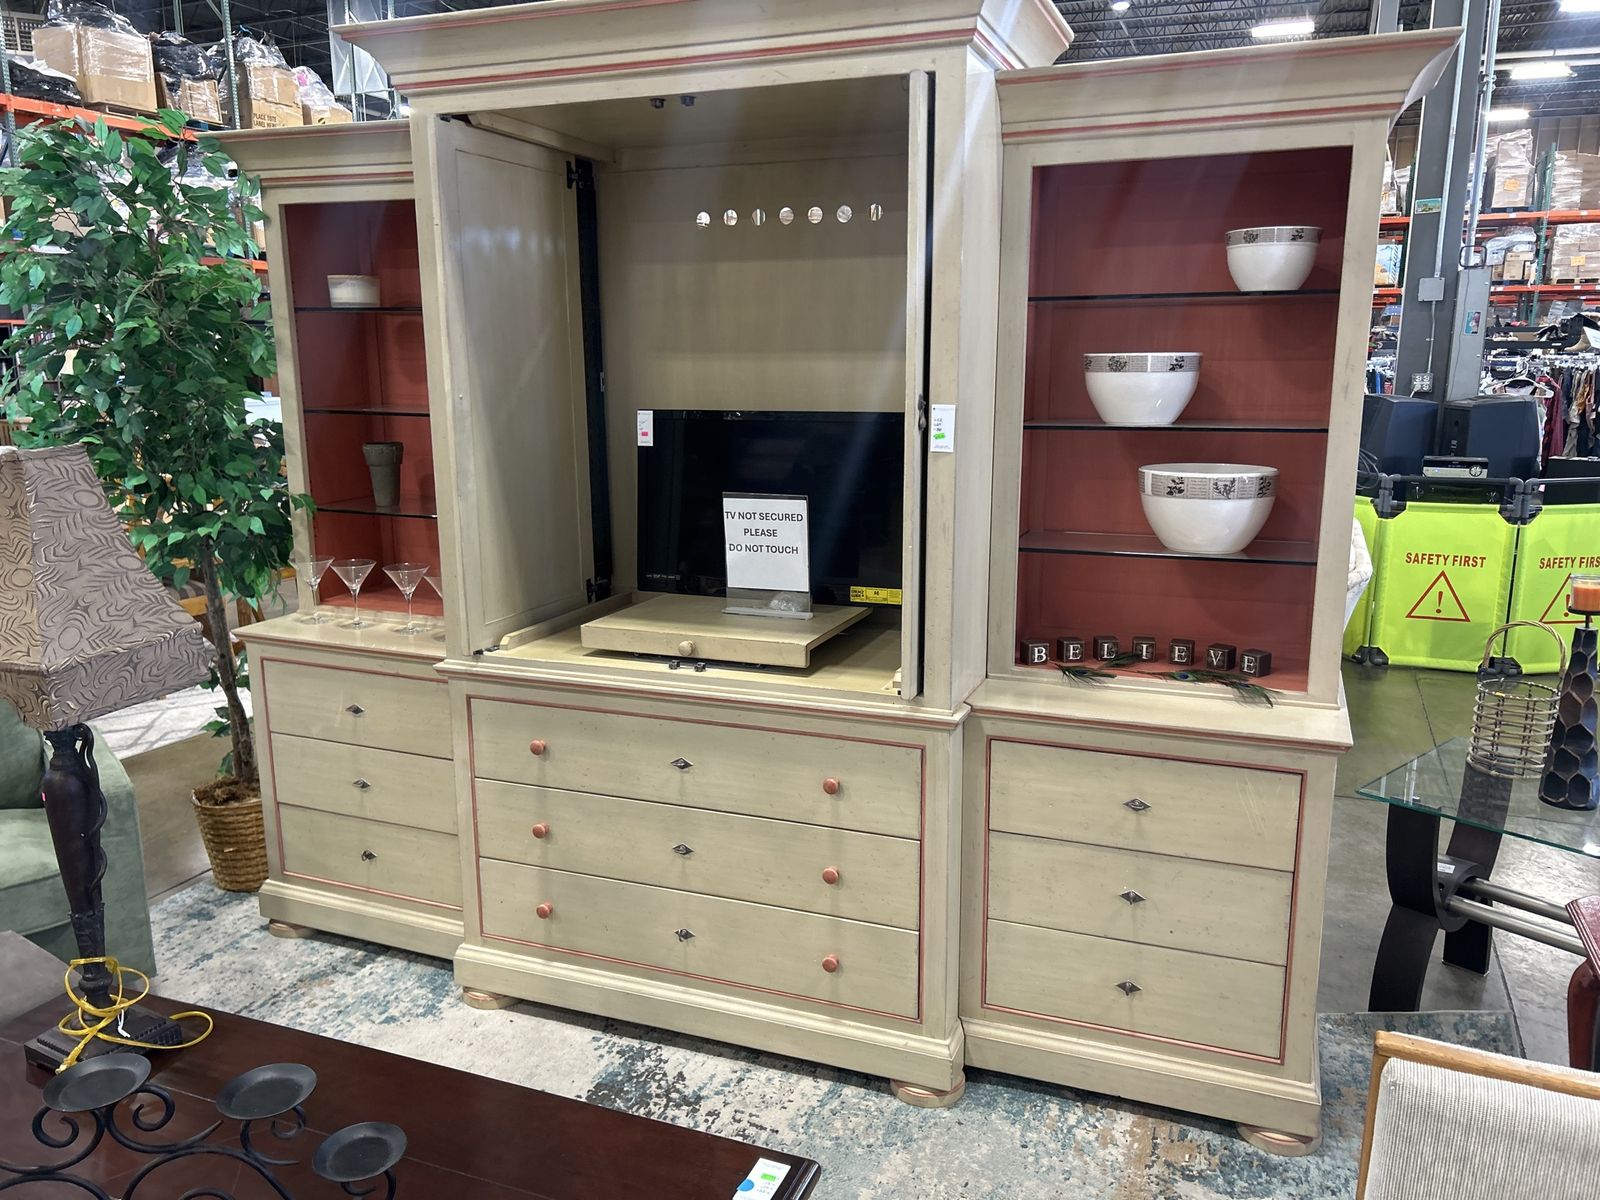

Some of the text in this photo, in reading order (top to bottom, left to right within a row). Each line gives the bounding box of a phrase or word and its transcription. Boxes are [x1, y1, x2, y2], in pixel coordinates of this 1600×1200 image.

[725, 511, 803, 522] TV NOT SECURED
[743, 528, 778, 537] PLEASE
[729, 543, 799, 554] DO NOT TOUCH
[1405, 552, 1487, 568] SAFETY FIRST
[1539, 556, 1577, 569] SAFETY
